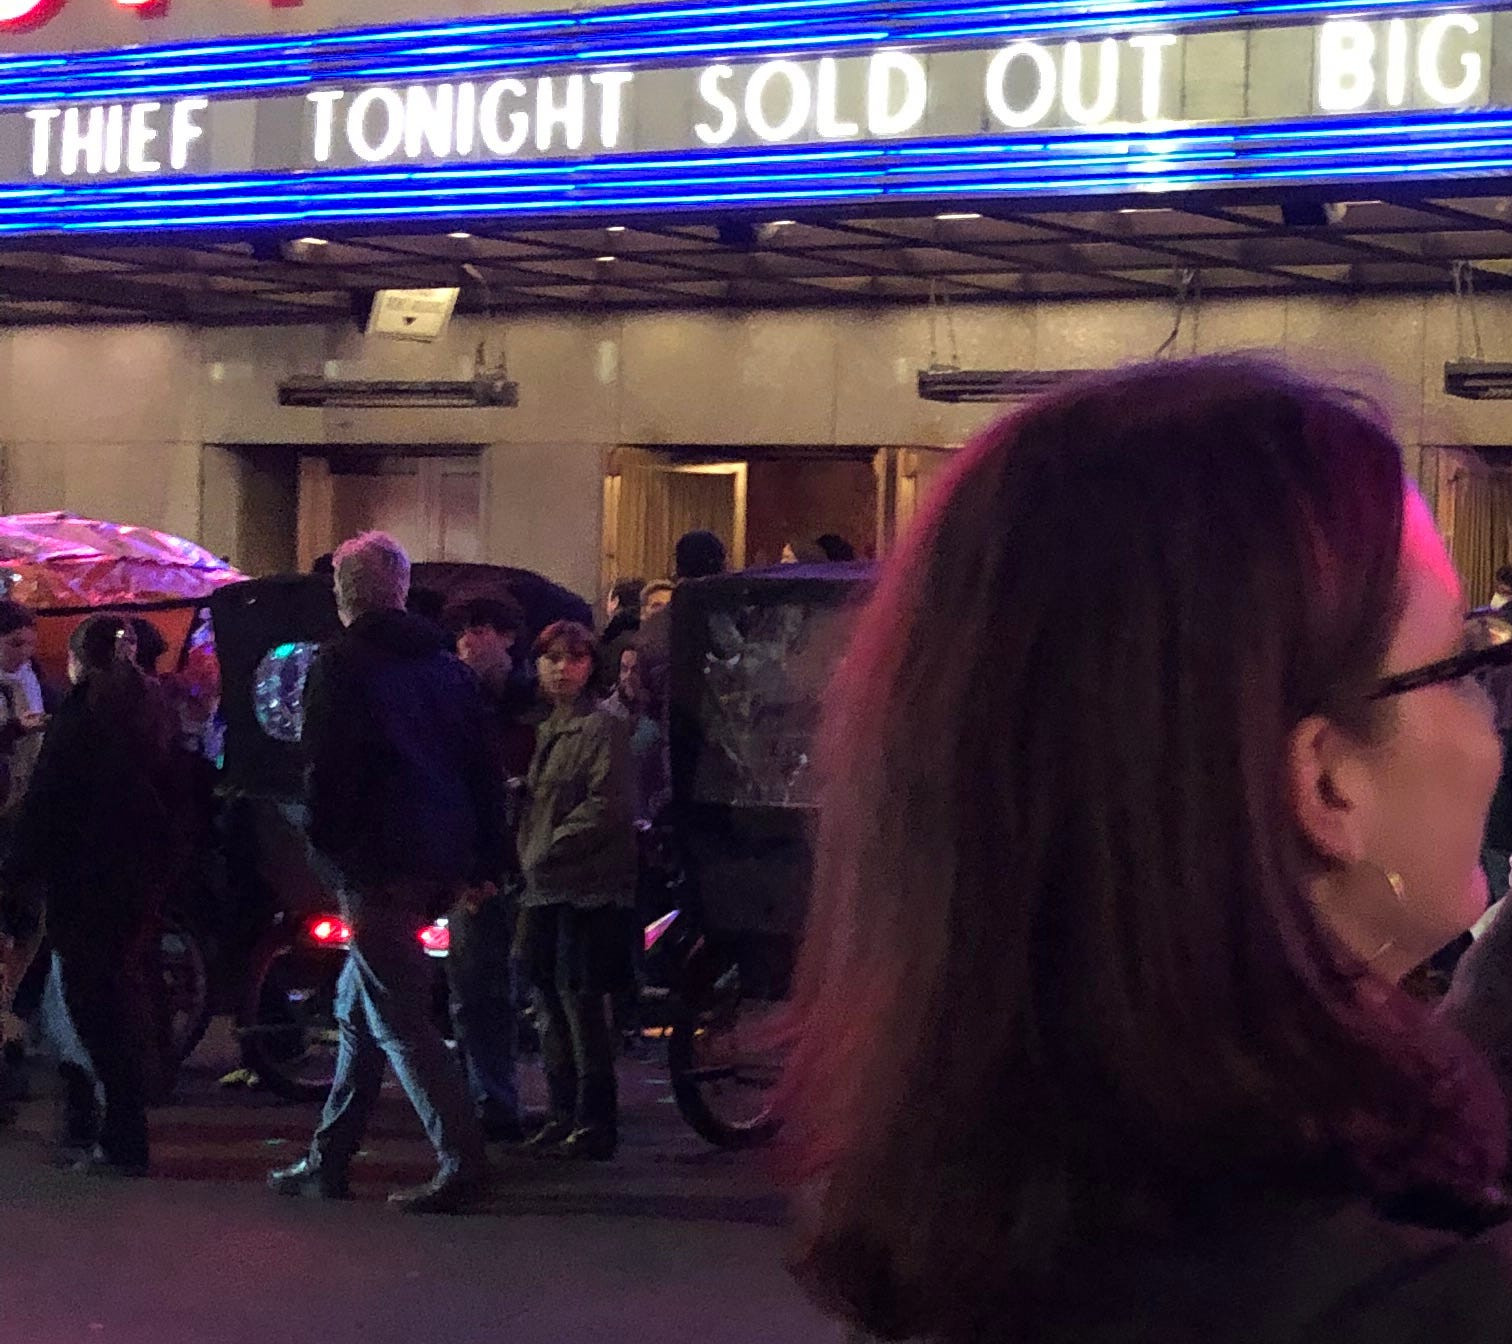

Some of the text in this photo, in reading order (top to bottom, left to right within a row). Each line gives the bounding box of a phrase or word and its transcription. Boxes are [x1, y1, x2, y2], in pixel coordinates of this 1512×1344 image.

[25, 98, 209, 176] THIEF
[306, 71, 634, 162] TONIGHT
[694, 47, 928, 145] SOLD
[984, 34, 1178, 129] OUT
[1317, 14, 1482, 112] BIG
